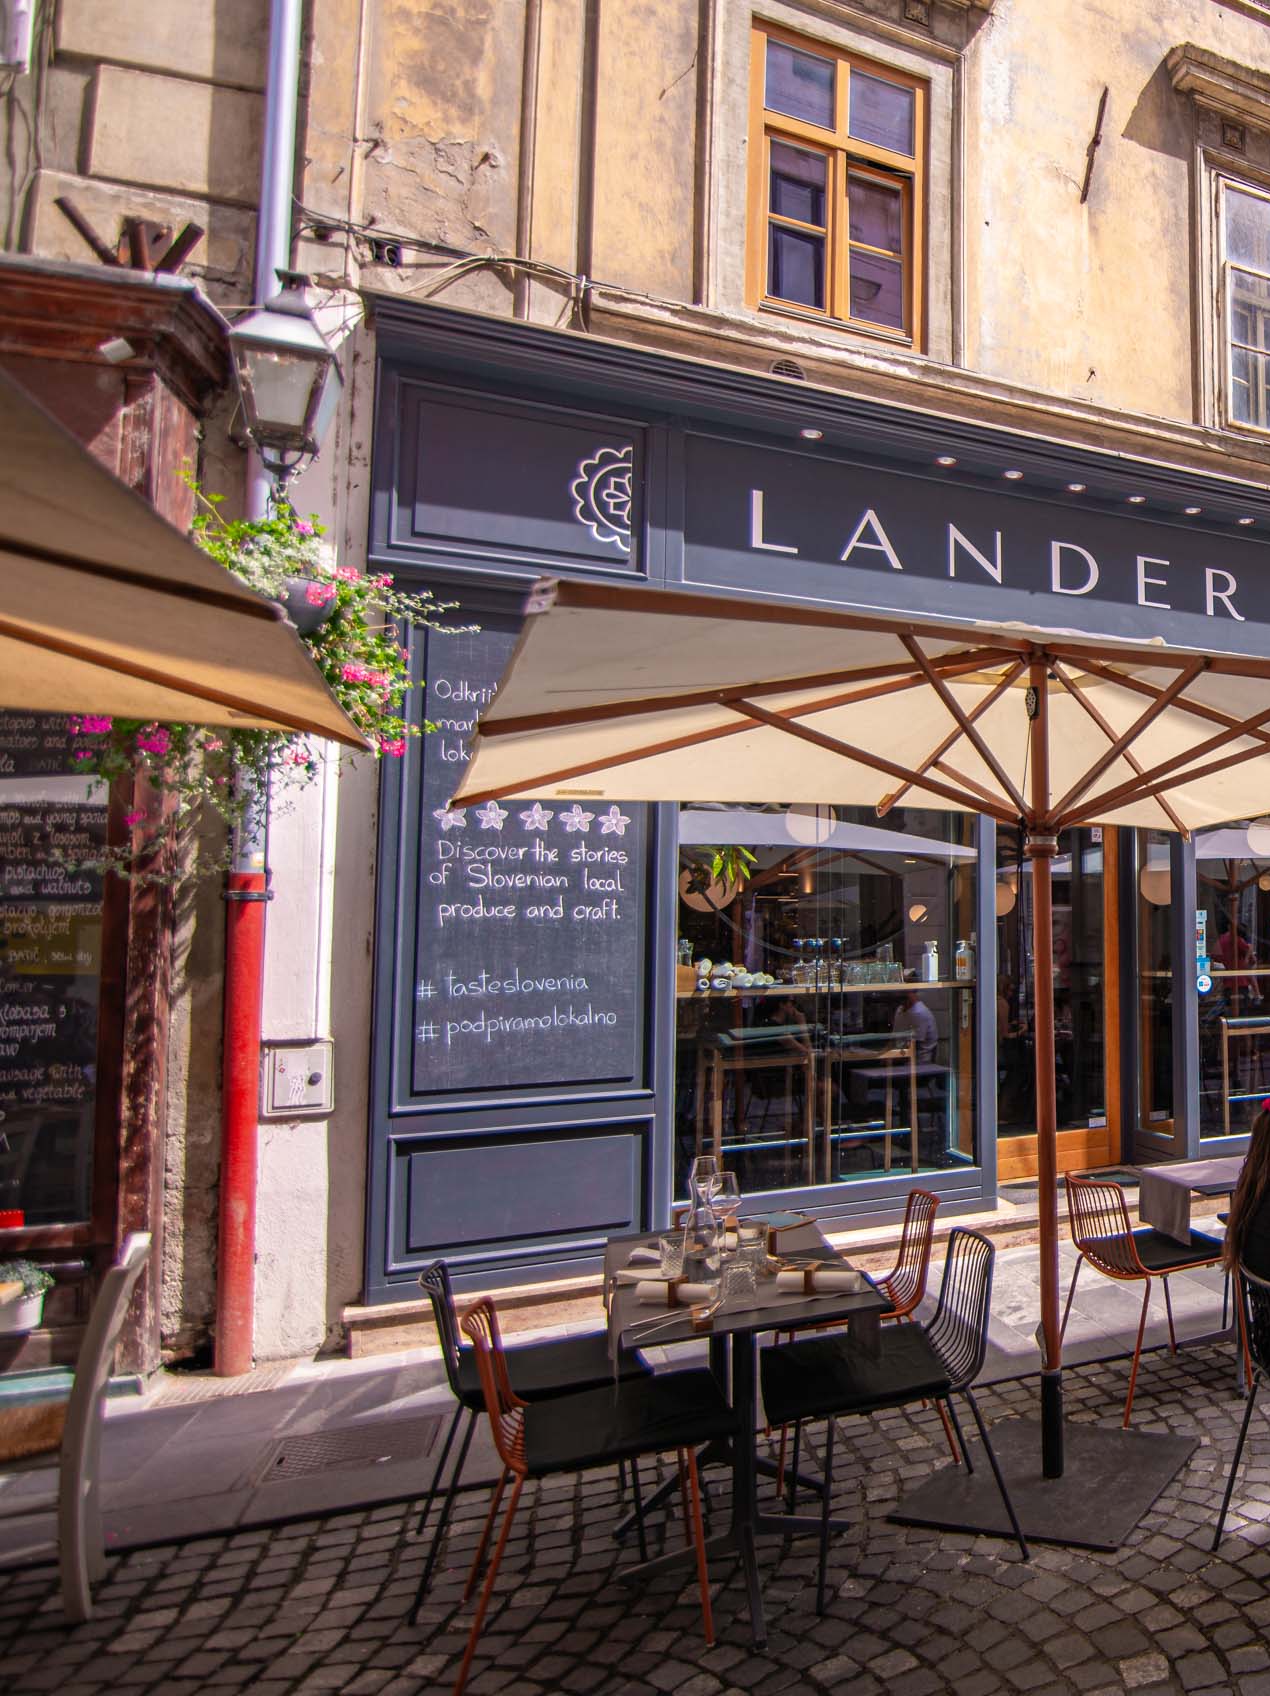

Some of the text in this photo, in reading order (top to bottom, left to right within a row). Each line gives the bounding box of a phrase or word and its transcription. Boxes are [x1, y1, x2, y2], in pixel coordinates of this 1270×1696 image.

[441, 739, 474, 762] lok
[438, 838, 629, 863] Discover the stories
[429, 863, 625, 891] of Slovenian local
[439, 895, 622, 928] produce and craft.
